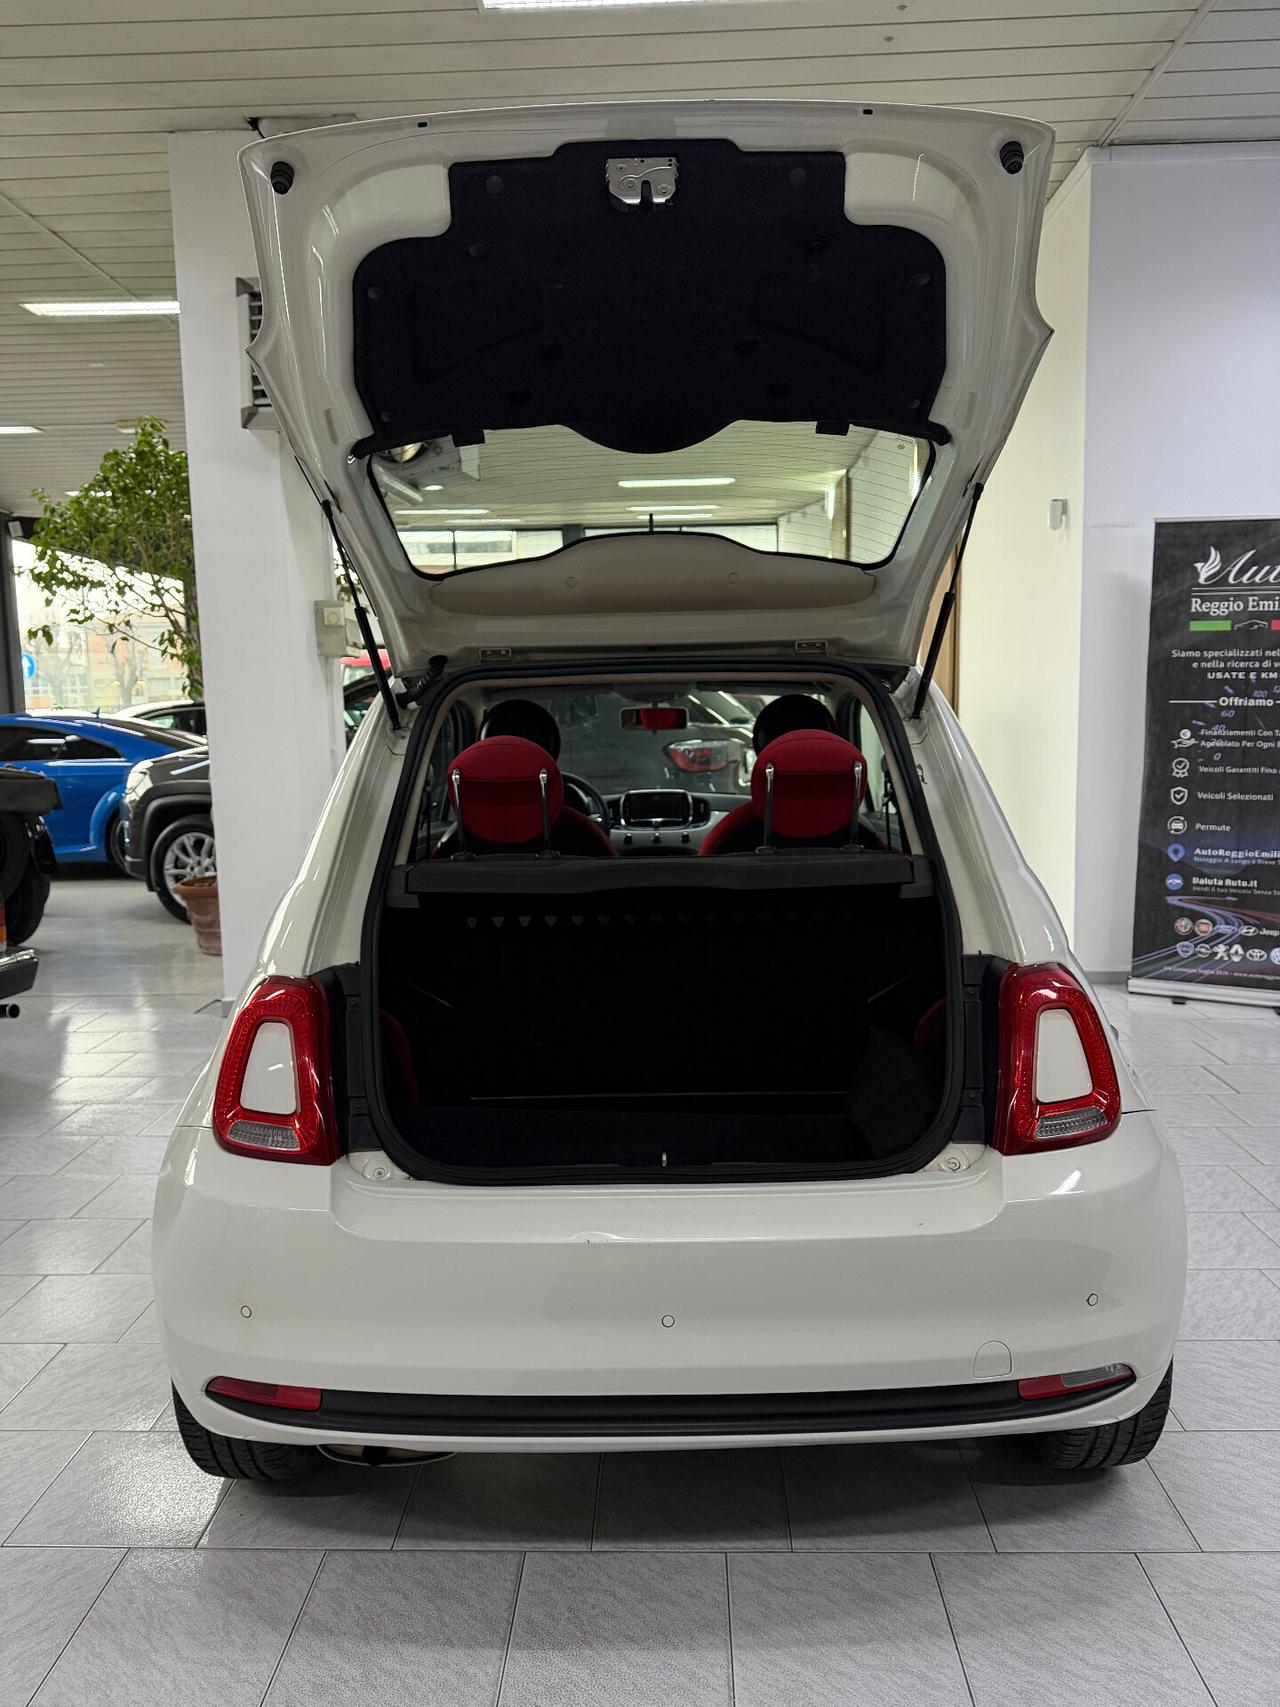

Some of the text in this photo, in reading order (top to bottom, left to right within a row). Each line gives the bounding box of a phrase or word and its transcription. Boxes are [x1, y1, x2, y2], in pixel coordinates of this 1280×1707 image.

[1191, 596, 1280, 616] Reggio Emi
[1171, 649, 1201, 658] Siamo
[1203, 648, 1263, 660] specializzati
[1200, 659, 1225, 668] nella
[1226, 659, 1260, 668] ricerca
[1261, 659, 1272, 668] di
[1207, 671, 1278, 679] USATE E KM
[1218, 696, 1274, 707] Offriamo
[1220, 709, 1236, 718] 60
[1257, 729, 1274, 737] Con
[1241, 740, 1255, 748] Per
[1256, 741, 1276, 749] Ogni
[1199, 765, 1278, 775] Veicoli Garantiti Fino
[1197, 791, 1274, 801] Veicoli Selezionati
[1195, 823, 1231, 832] Permute
[1259, 928, 1280, 937] Jeep
